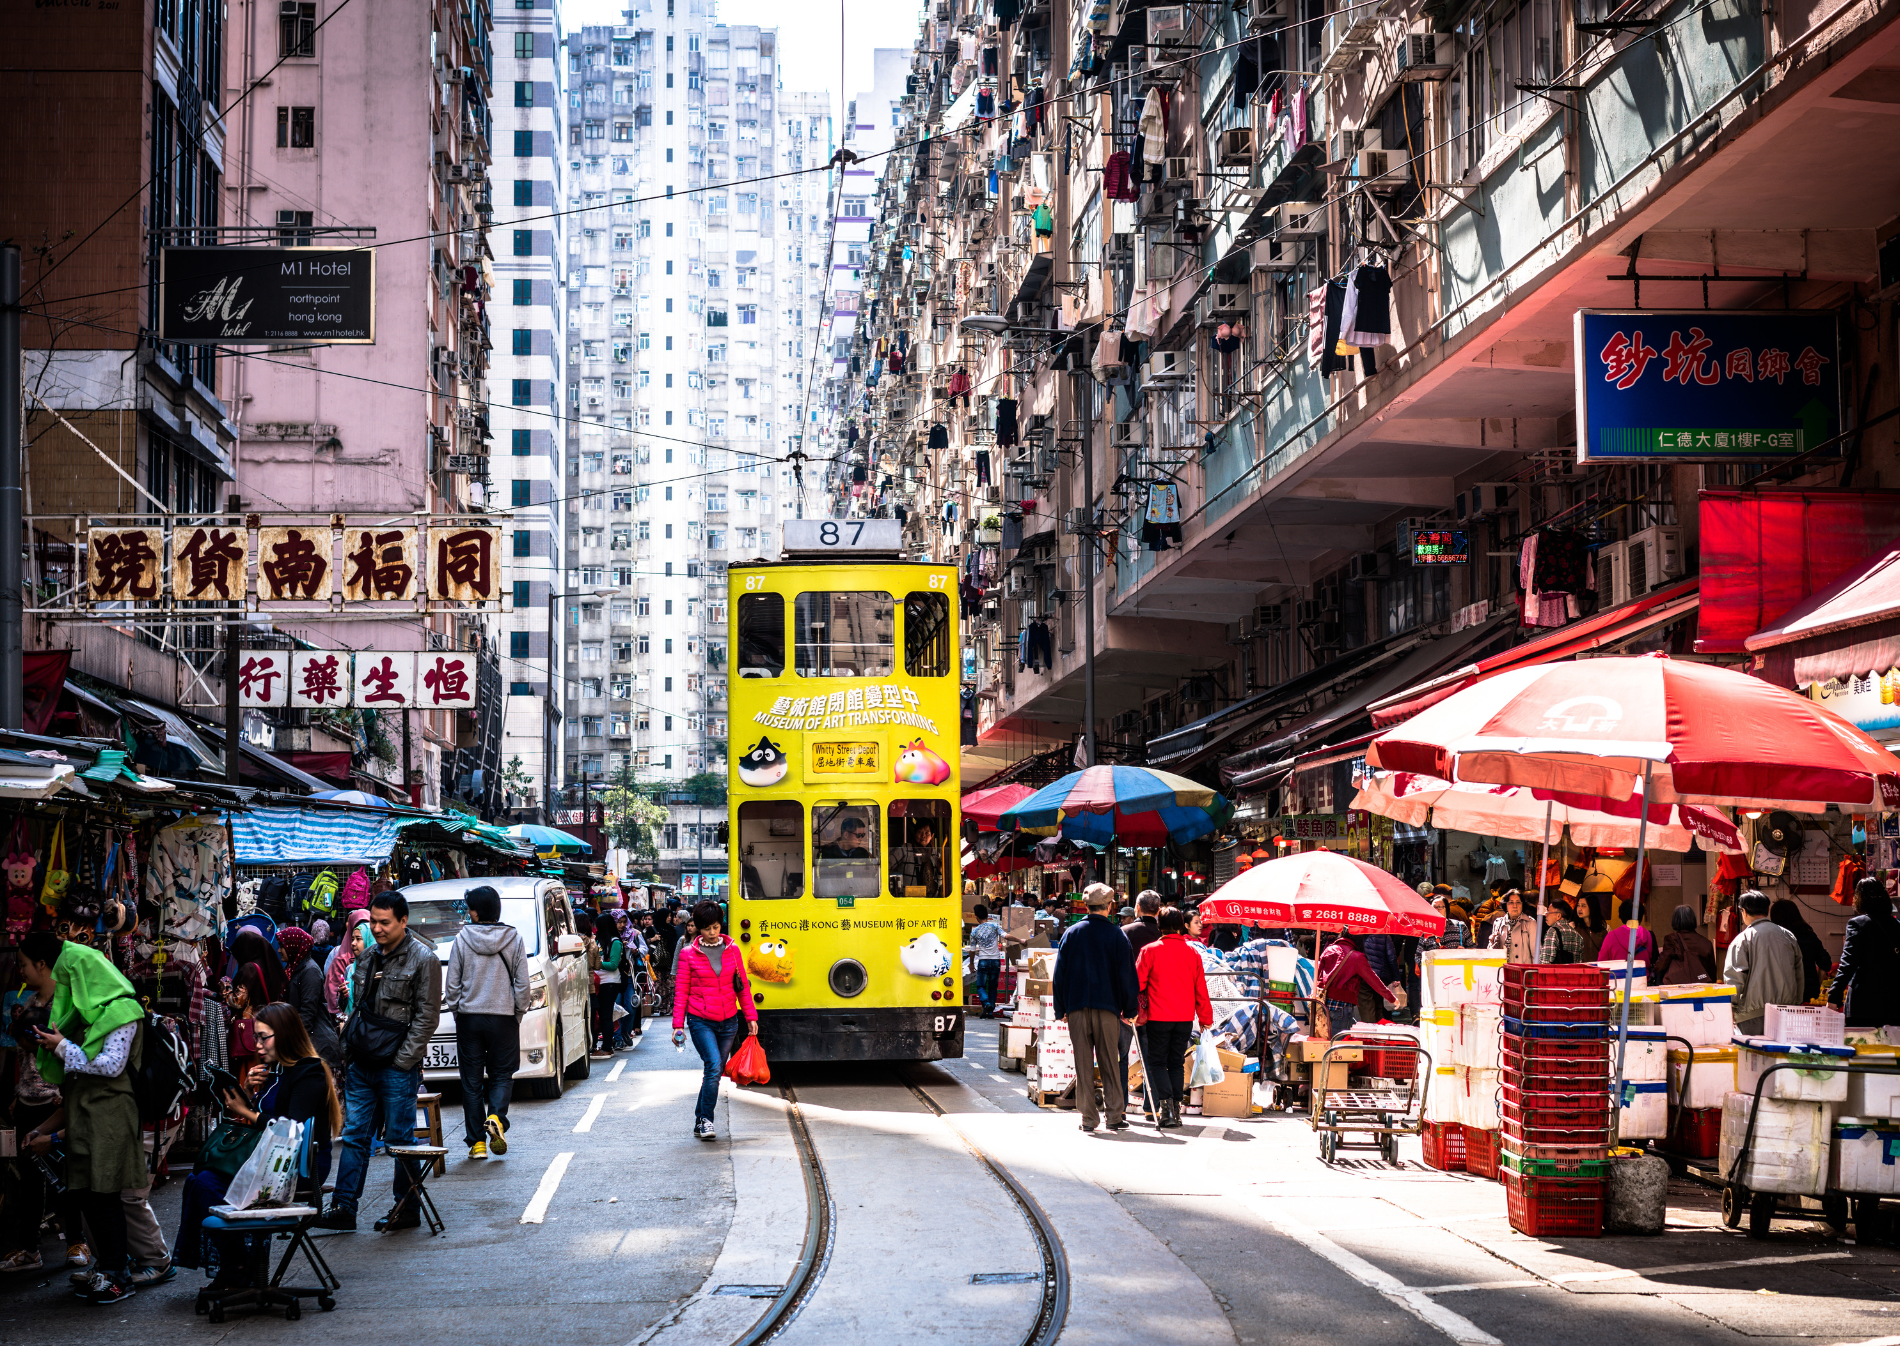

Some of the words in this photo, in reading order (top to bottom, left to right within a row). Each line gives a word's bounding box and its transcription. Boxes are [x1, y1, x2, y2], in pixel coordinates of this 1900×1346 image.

[98, 1, 119, 10] 2011
[281, 262, 302, 275] M1
[310, 262, 351, 275] Hotel
[289, 294, 340, 305] northpoint
[288, 312, 314, 323] hong
[317, 312, 342, 323] kong
[220, 321, 252, 337] hotel
[303, 329, 365, 337] www.m1hotel.hk
[1658, 431, 1795, 448] 仁德大廈1樓F-G室
[820, 521, 865, 546] 87
[745, 575, 765, 590] 87
[929, 574, 947, 589] 87
[769, 684, 921, 717] 藝術館閉館變型中
[753, 711, 805, 730] MUSEUM
[805, 716, 822, 730] OF
[823, 713, 846, 729] ART
[849, 709, 939, 736] TRANSFORMING
[815, 744, 835, 756] Whitty
[836, 744, 856, 755] Street
[857, 744, 876, 756] Depot
[839, 897, 853, 905] 054
[759, 919, 769, 931] 香
[771, 921, 797, 930] HONG
[799, 919, 810, 931] 港
[811, 920, 838, 929] KONG
[840, 919, 851, 931] 藝
[853, 920, 894, 929] MUSEUM
[895, 918, 906, 931] 術
[907, 920, 920, 928] OF
[920, 919, 937, 928] ART
[938, 917, 948, 930] 館
[1316, 910, 1343, 920] 2681
[1348, 912, 1378, 924] 8888
[934, 1014, 957, 1032] 87
[432, 1045, 449, 1056] SL
[424, 1055, 457, 1067] 3394
